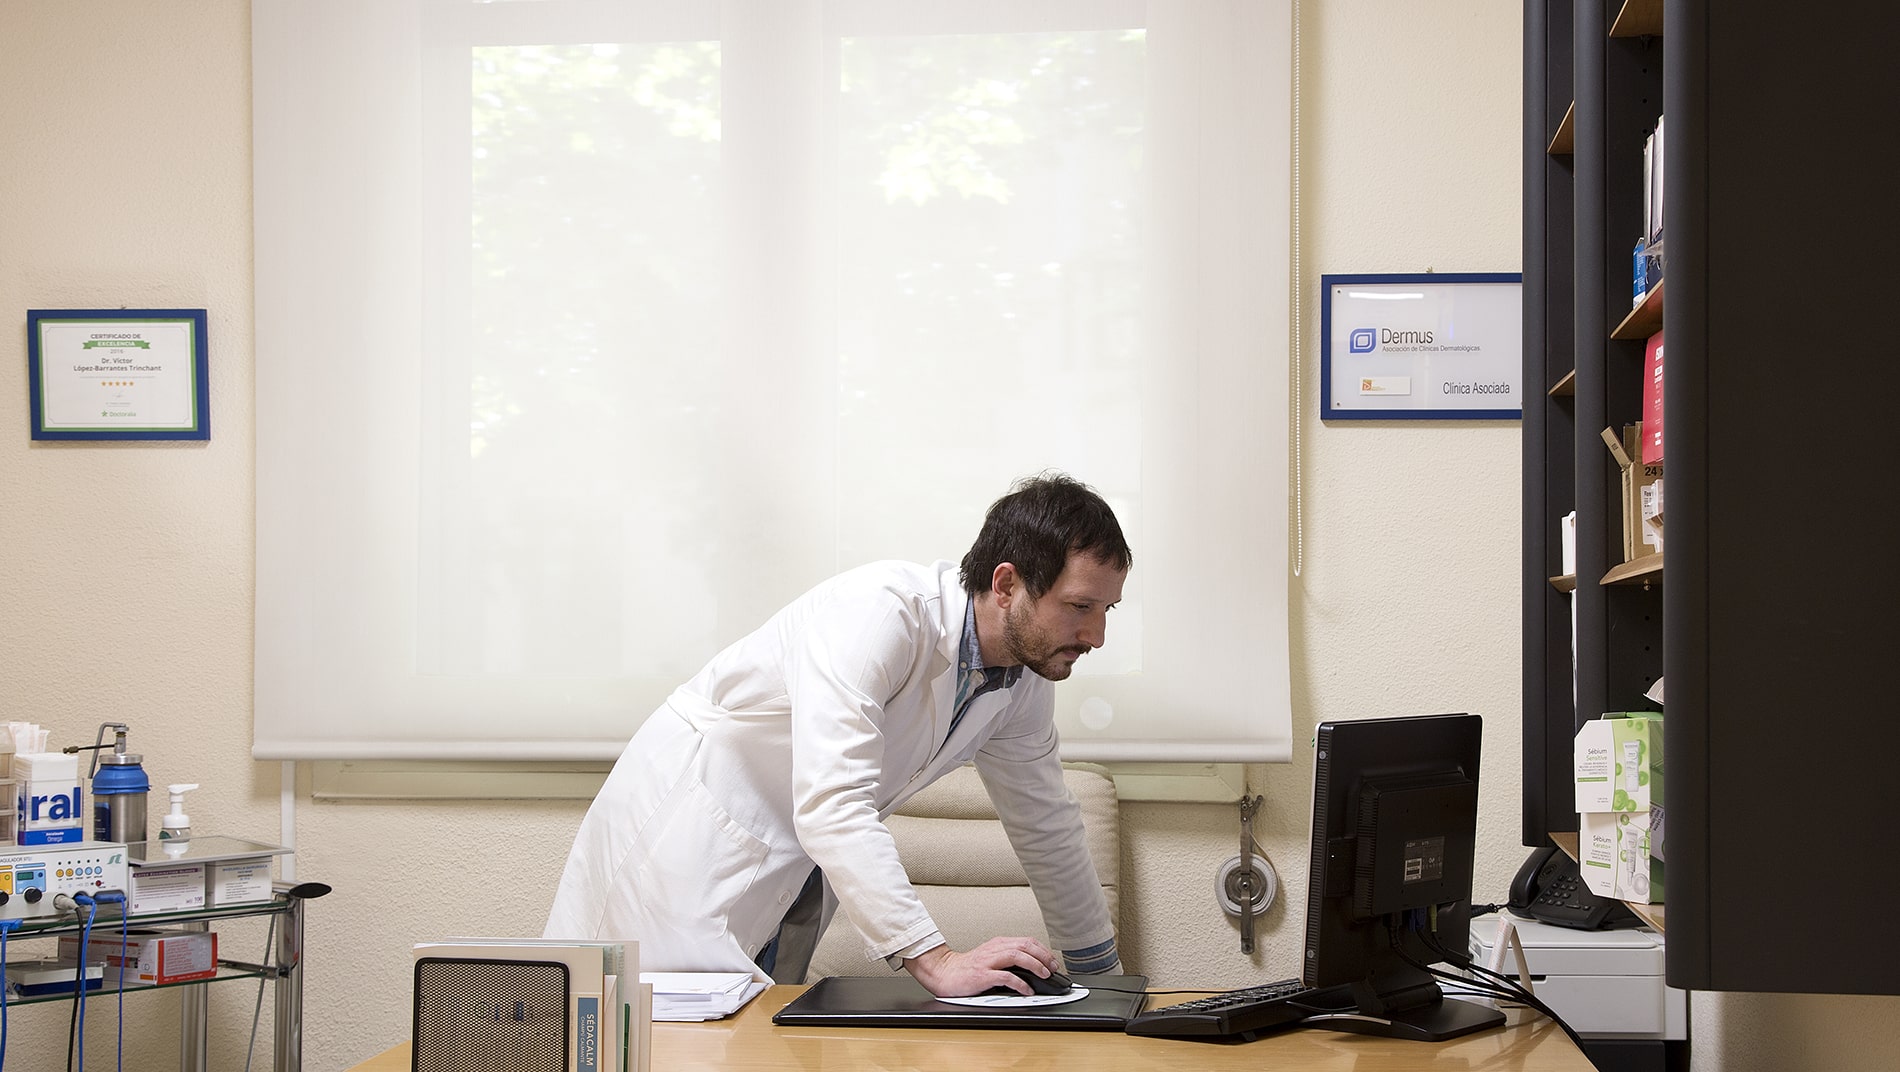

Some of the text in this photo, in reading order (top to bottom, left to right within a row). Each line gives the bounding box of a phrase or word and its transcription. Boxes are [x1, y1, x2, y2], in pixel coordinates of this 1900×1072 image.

[1381, 328, 1433, 344] Dermus
[1472, 381, 1510, 394] Asociada
[1644, 466, 1657, 476] 24
[586, 1013, 596, 1066] SÉDACALM
